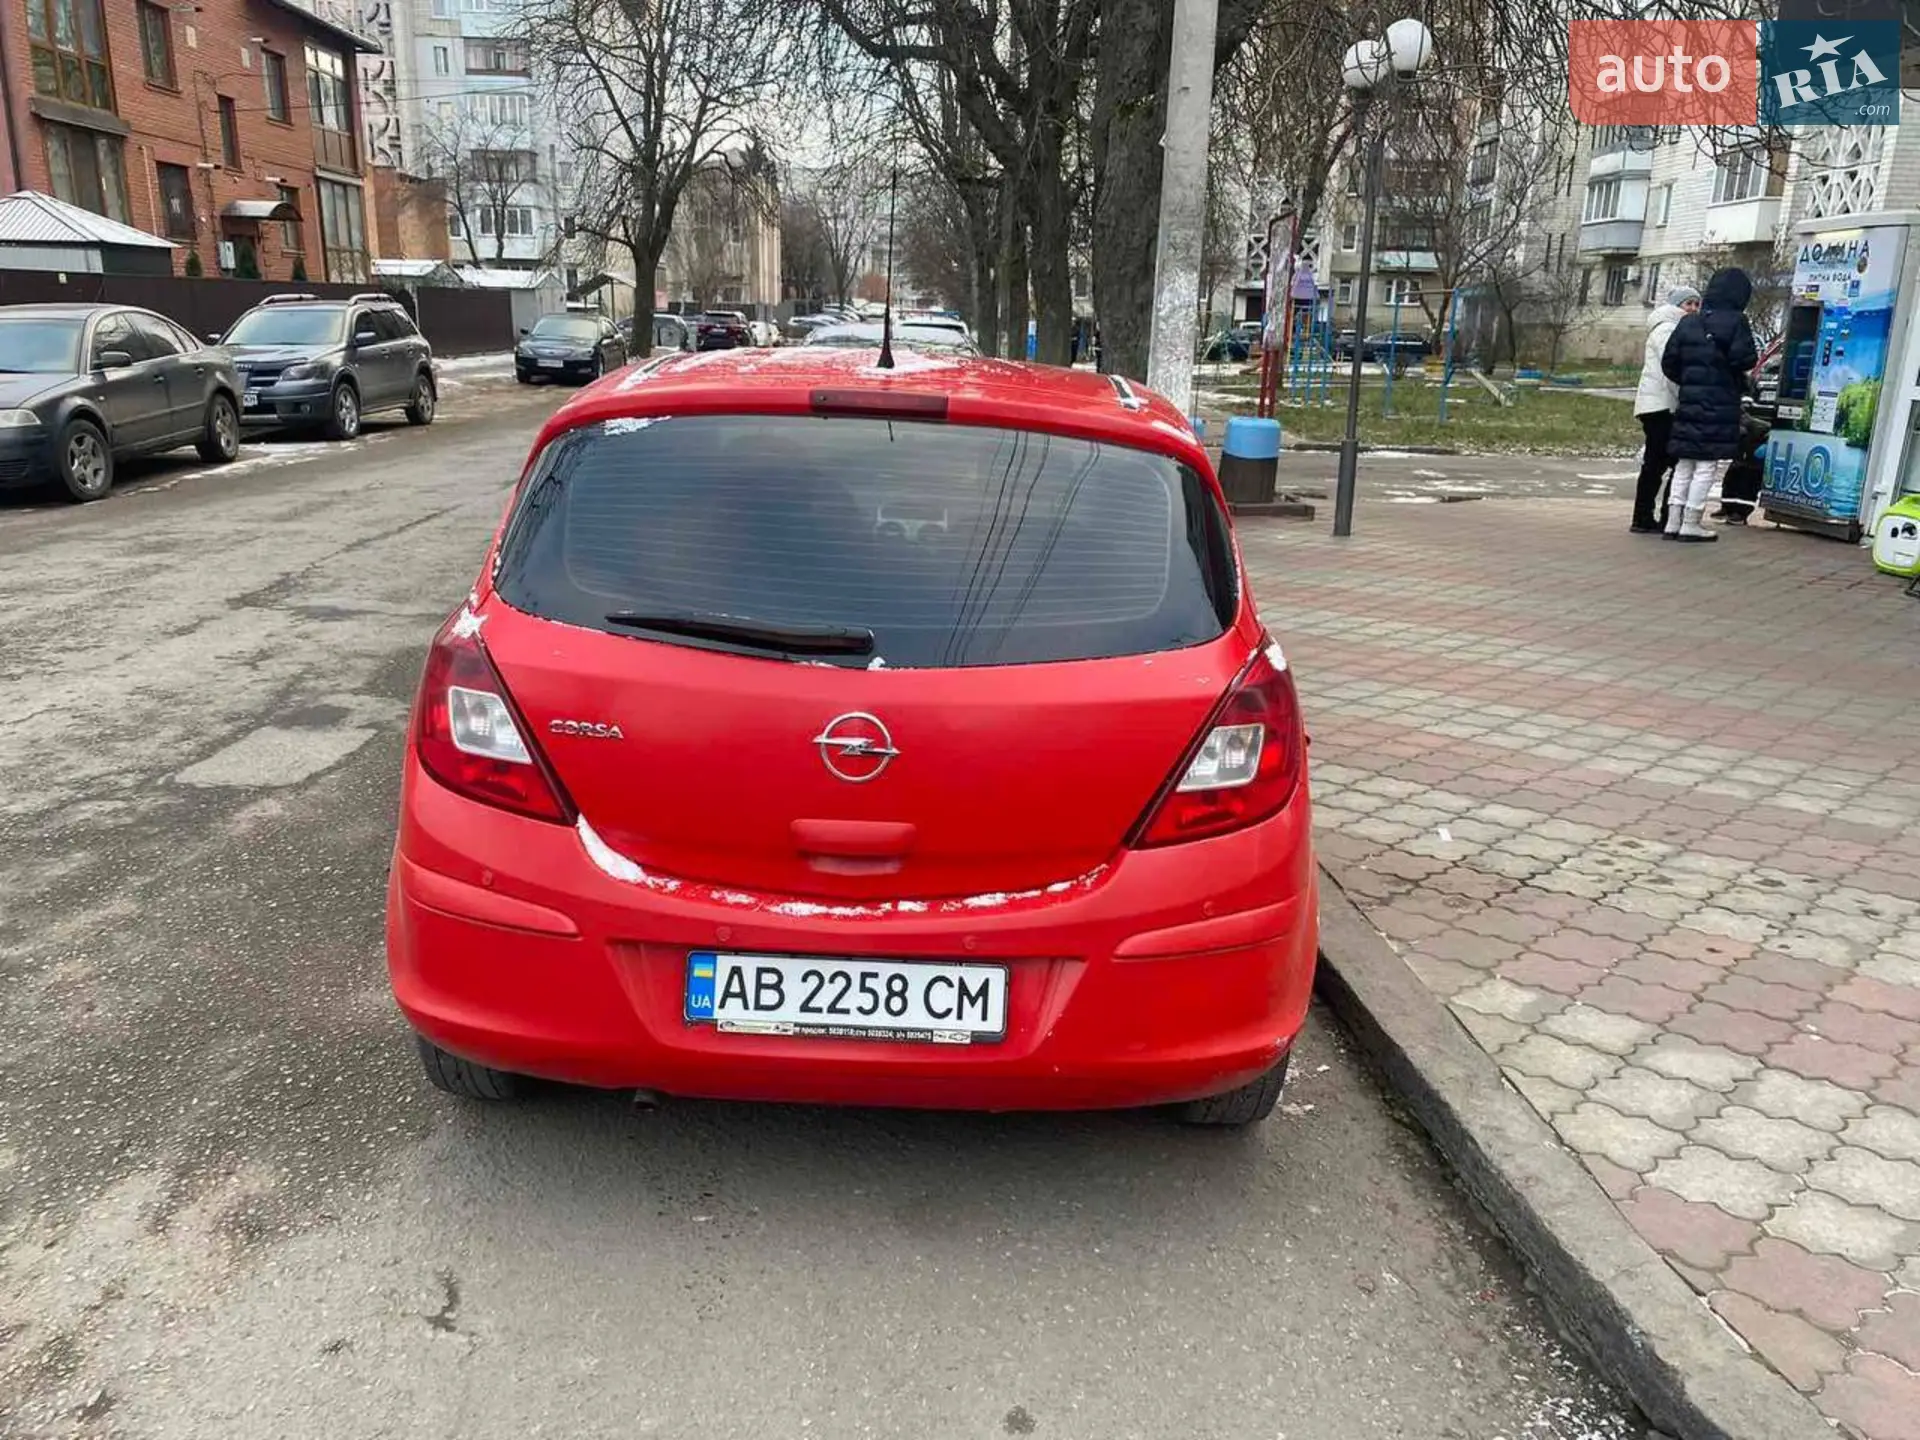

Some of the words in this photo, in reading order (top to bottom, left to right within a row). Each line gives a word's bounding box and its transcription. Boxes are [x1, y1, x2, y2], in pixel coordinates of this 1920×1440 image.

[549, 719, 625, 739] CORSA
[691, 994, 713, 1009] UA
[718, 965, 786, 1012] AB
[798, 968, 909, 1017] 2258
[923, 974, 990, 1022] CM
